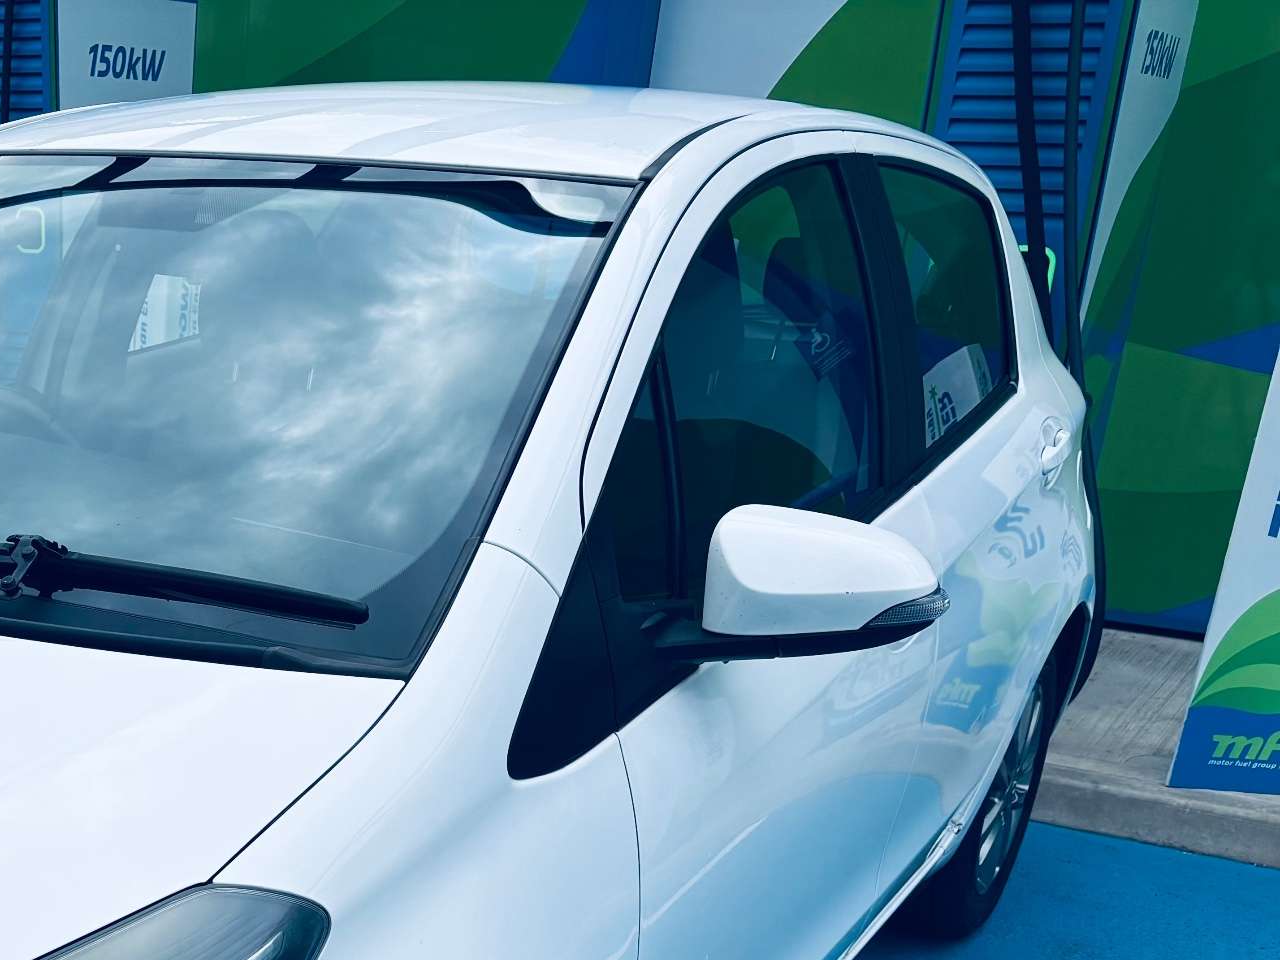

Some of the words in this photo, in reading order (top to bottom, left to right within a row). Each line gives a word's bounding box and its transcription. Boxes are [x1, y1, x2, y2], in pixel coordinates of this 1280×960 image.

[88, 43, 166, 82] 150kW
[1140, 29, 1181, 80] 150kW
[1252, 761, 1277, 770] group
